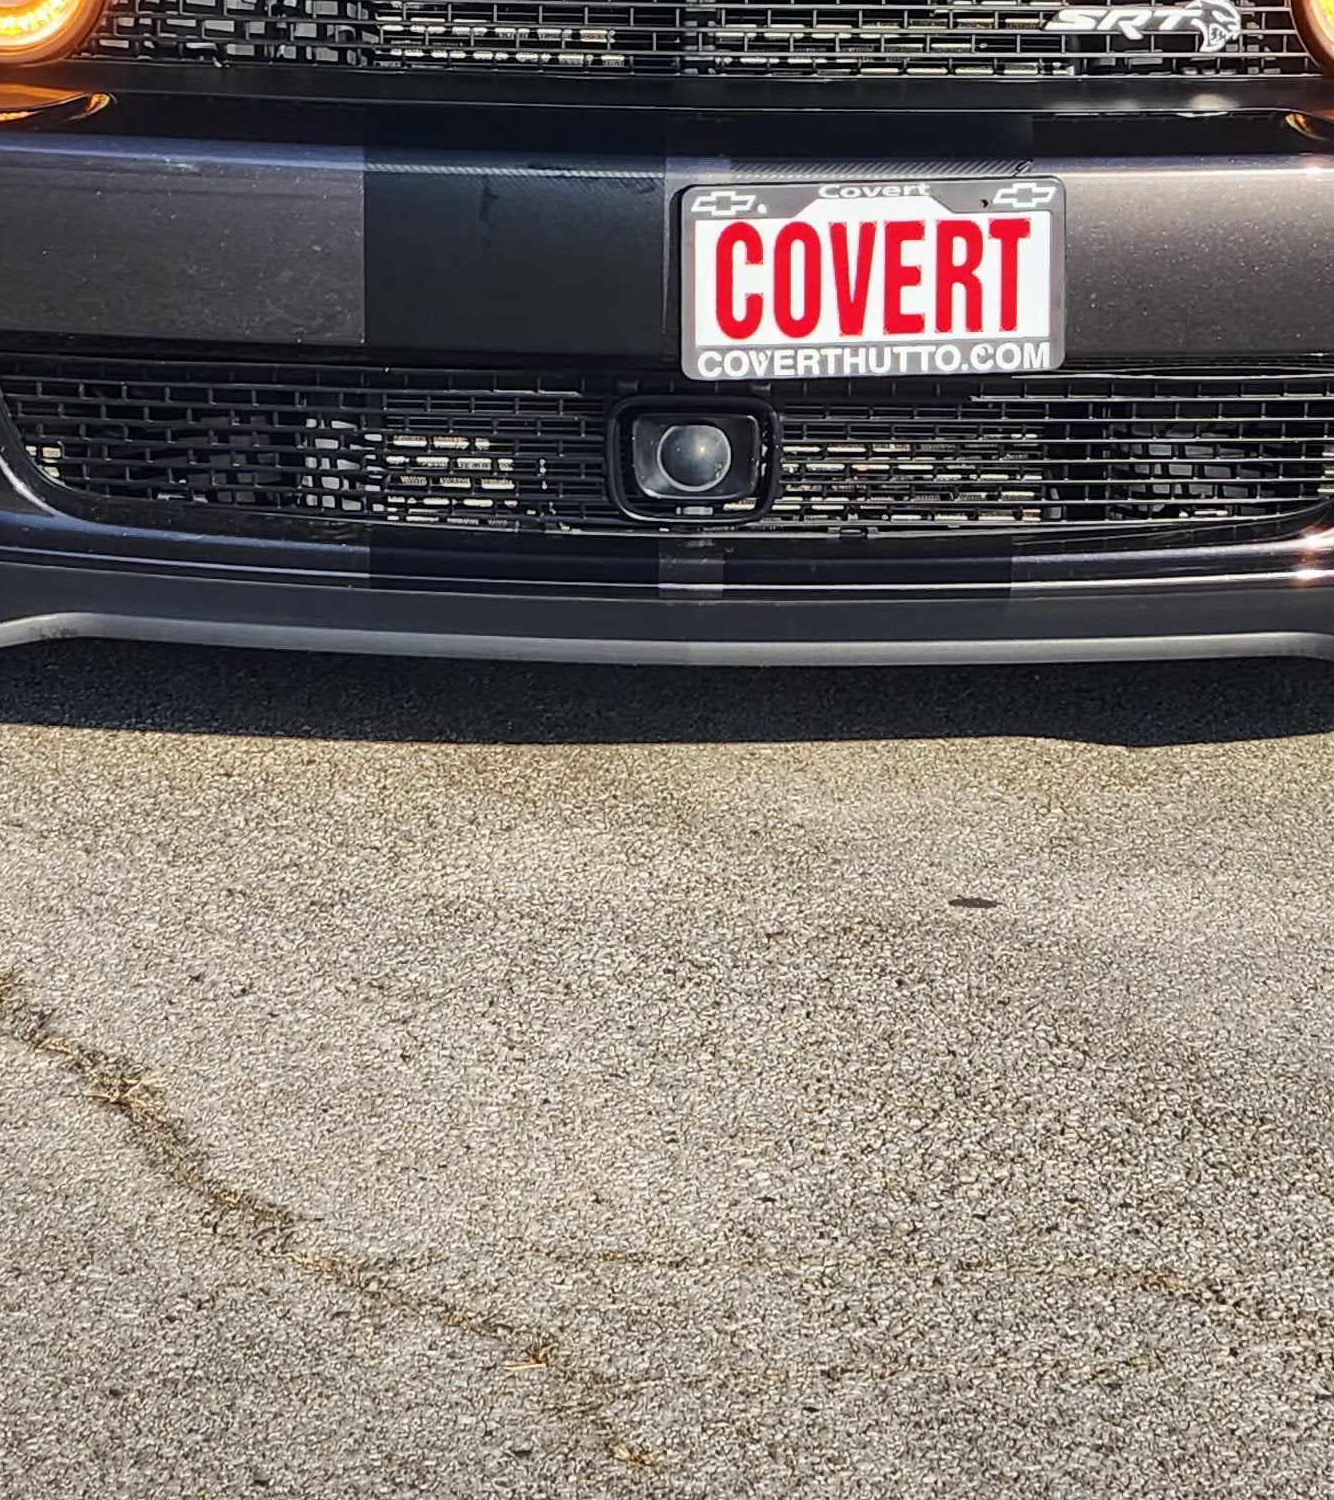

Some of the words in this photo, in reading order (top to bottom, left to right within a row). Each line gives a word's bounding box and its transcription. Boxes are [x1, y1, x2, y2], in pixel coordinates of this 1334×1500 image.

[1044, 7, 1203, 40] SRT
[817, 182, 931, 200] Covert
[715, 217, 1031, 340] COVERT
[696, 341, 1051, 378] COVERTHUTTO.COM
